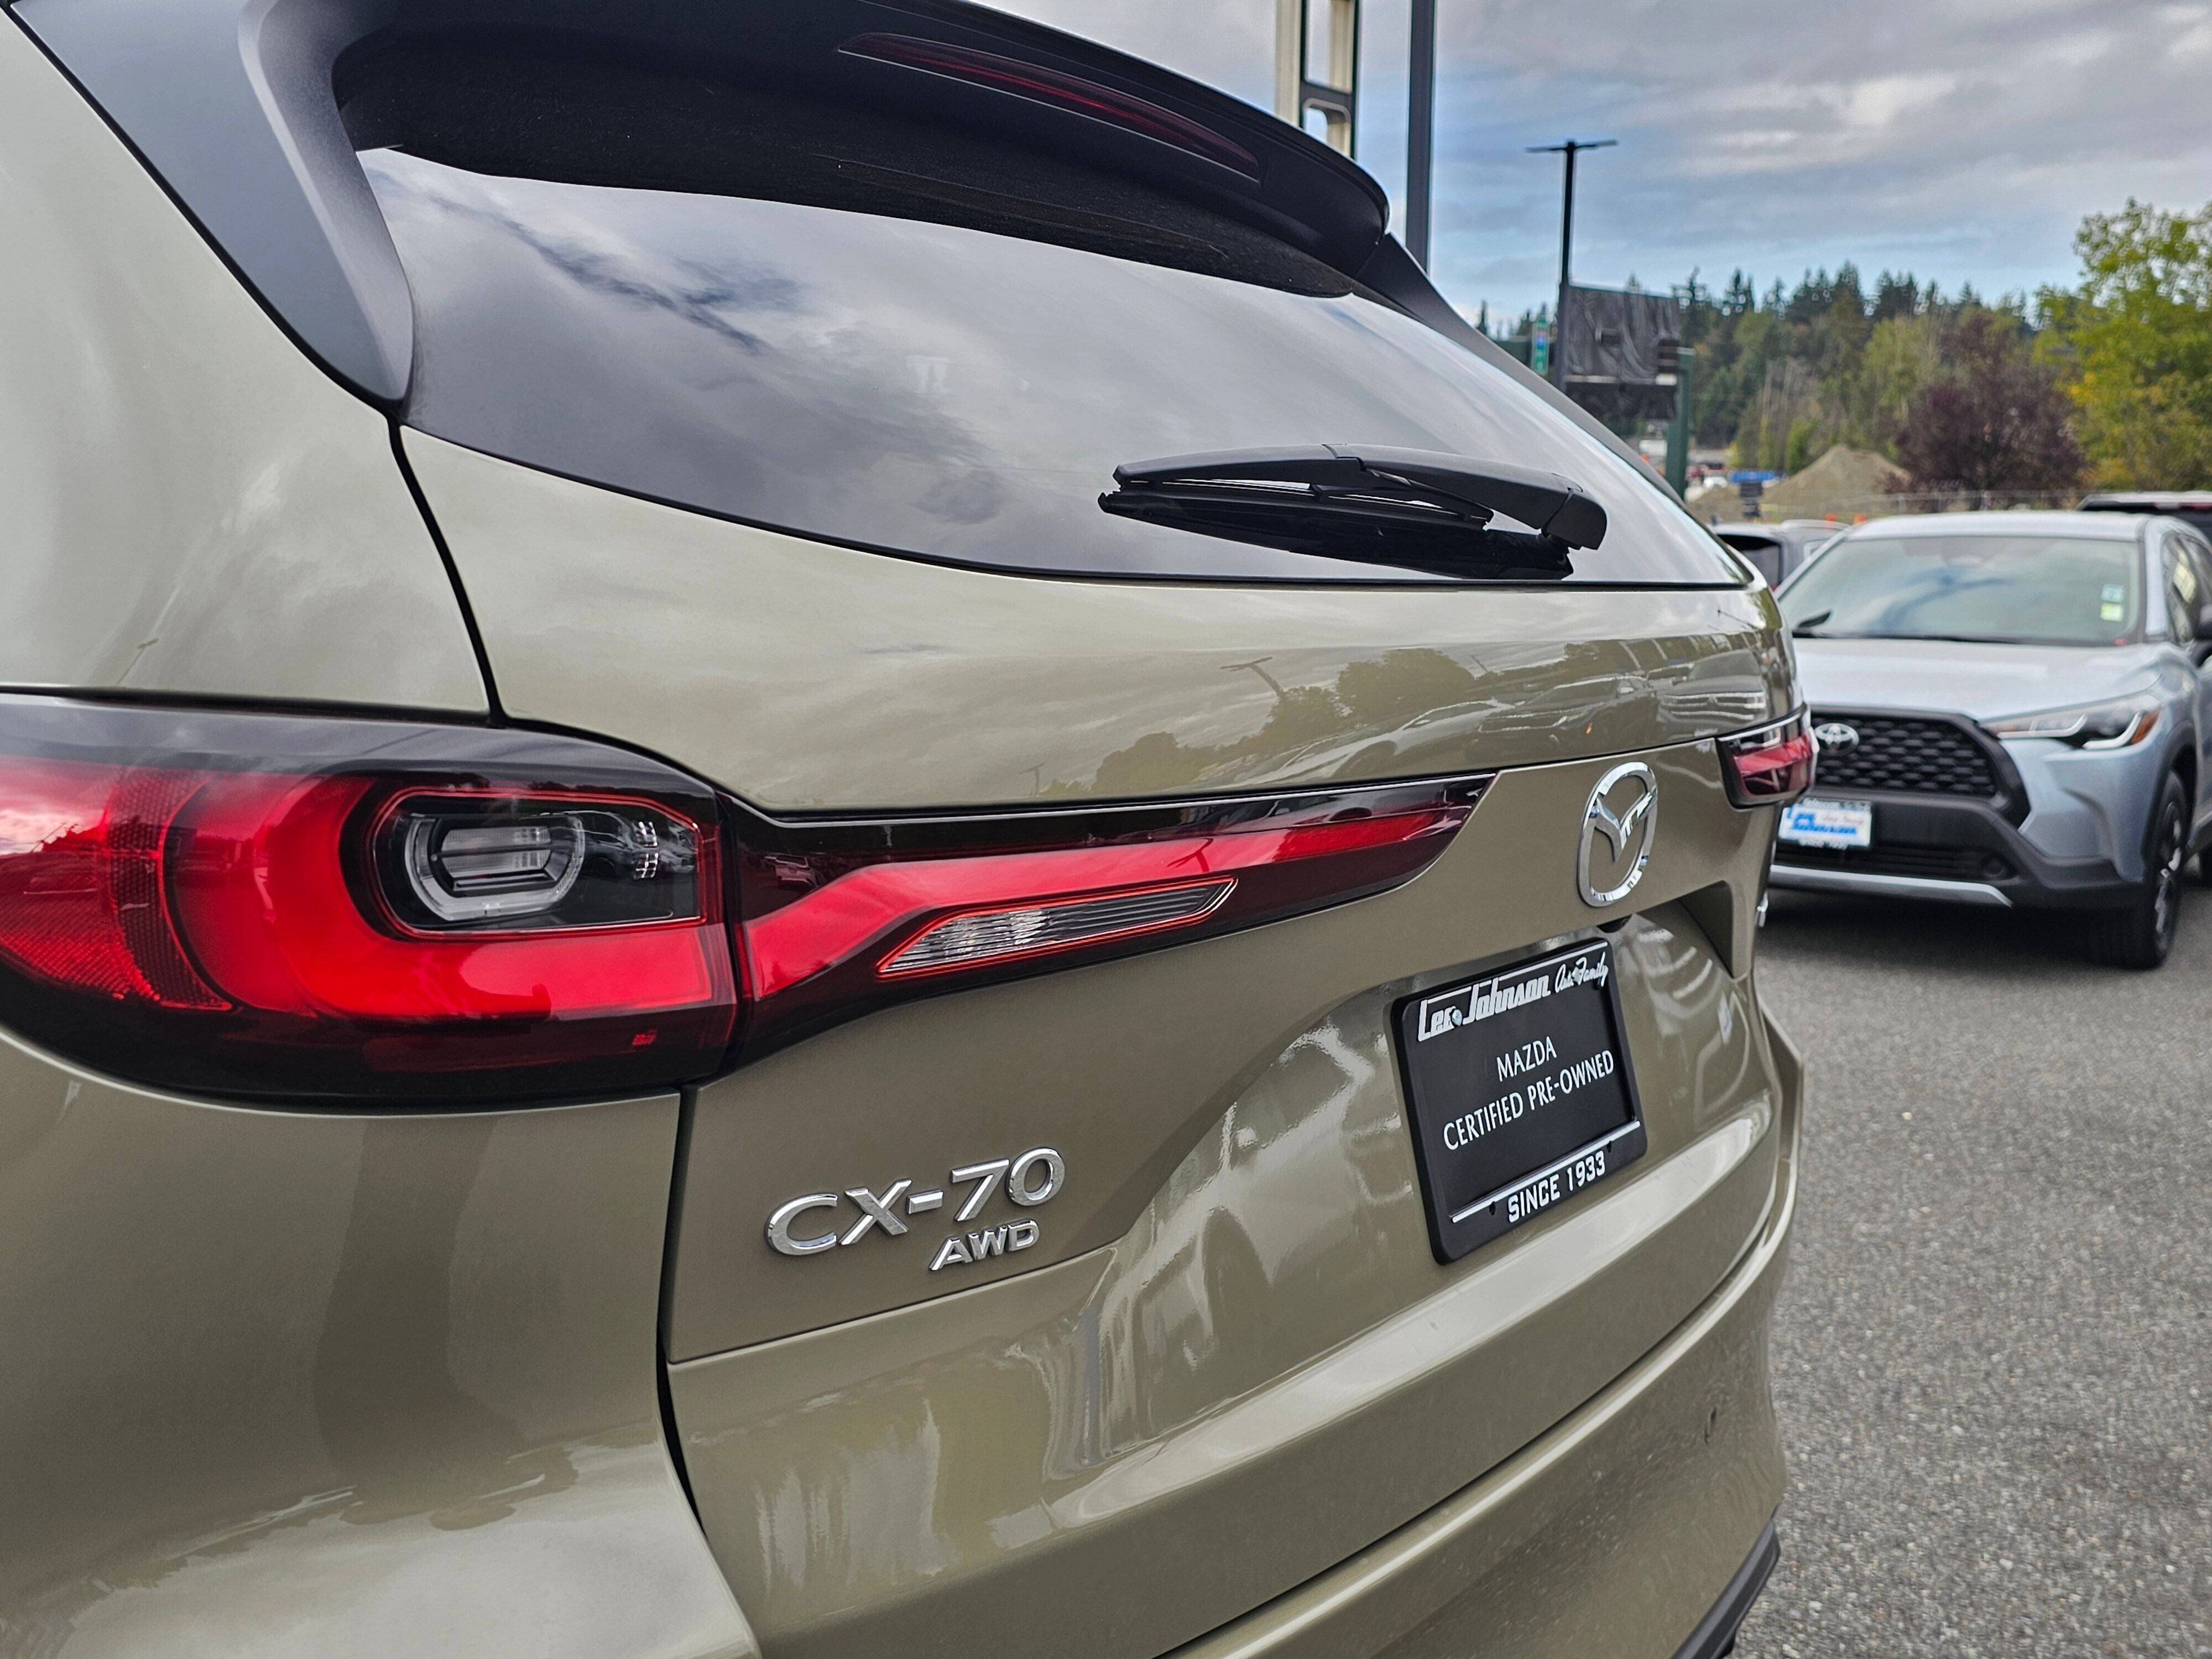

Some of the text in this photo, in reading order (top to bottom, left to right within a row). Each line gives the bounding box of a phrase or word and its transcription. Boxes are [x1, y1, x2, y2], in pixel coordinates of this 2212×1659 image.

[1417, 951, 1609, 1042] Lee Johnson Aut Family
[1496, 1036, 1557, 1082] MAZDA
[1443, 1050, 1615, 1151] CERTIFIED PRE-OWNED
[764, 1146, 1066, 1256] CX-70
[1507, 1150, 1606, 1223] SINCE 1933
[928, 1218, 1040, 1271] AWD
